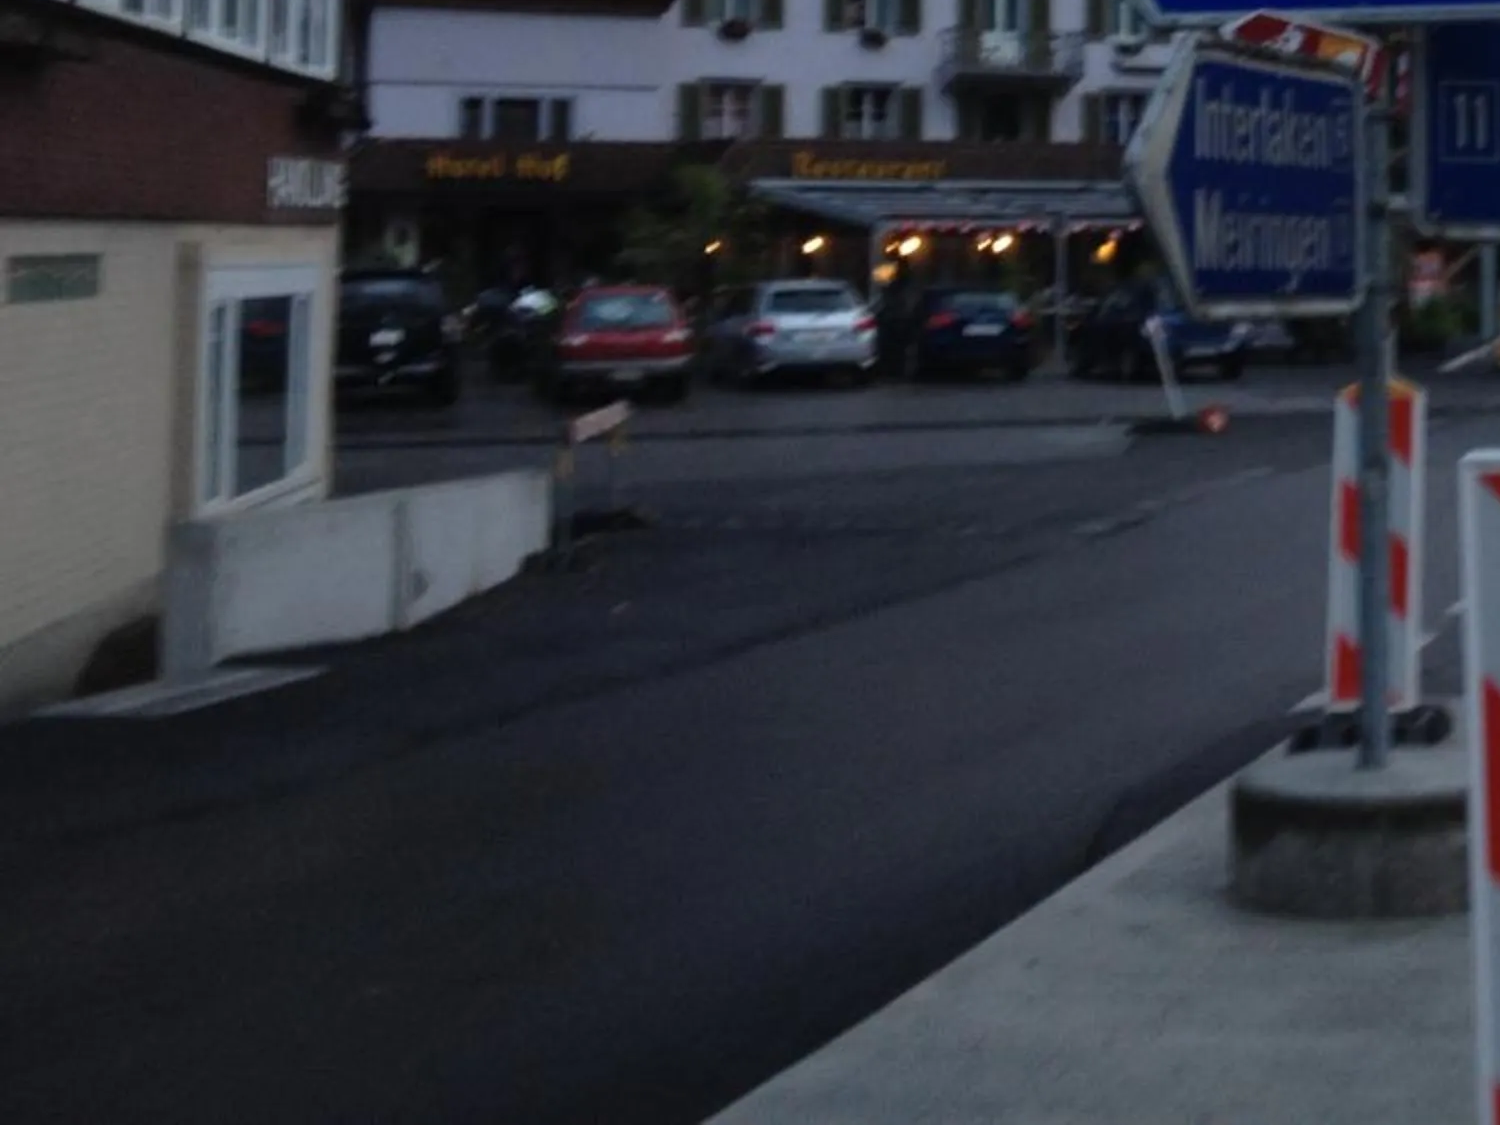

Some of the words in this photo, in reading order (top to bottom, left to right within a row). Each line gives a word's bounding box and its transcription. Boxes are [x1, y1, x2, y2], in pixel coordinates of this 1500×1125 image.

[1194, 77, 1332, 170] Interlaken
[1453, 93, 1488, 150] 11
[1194, 187, 1329, 291] Meiringen
